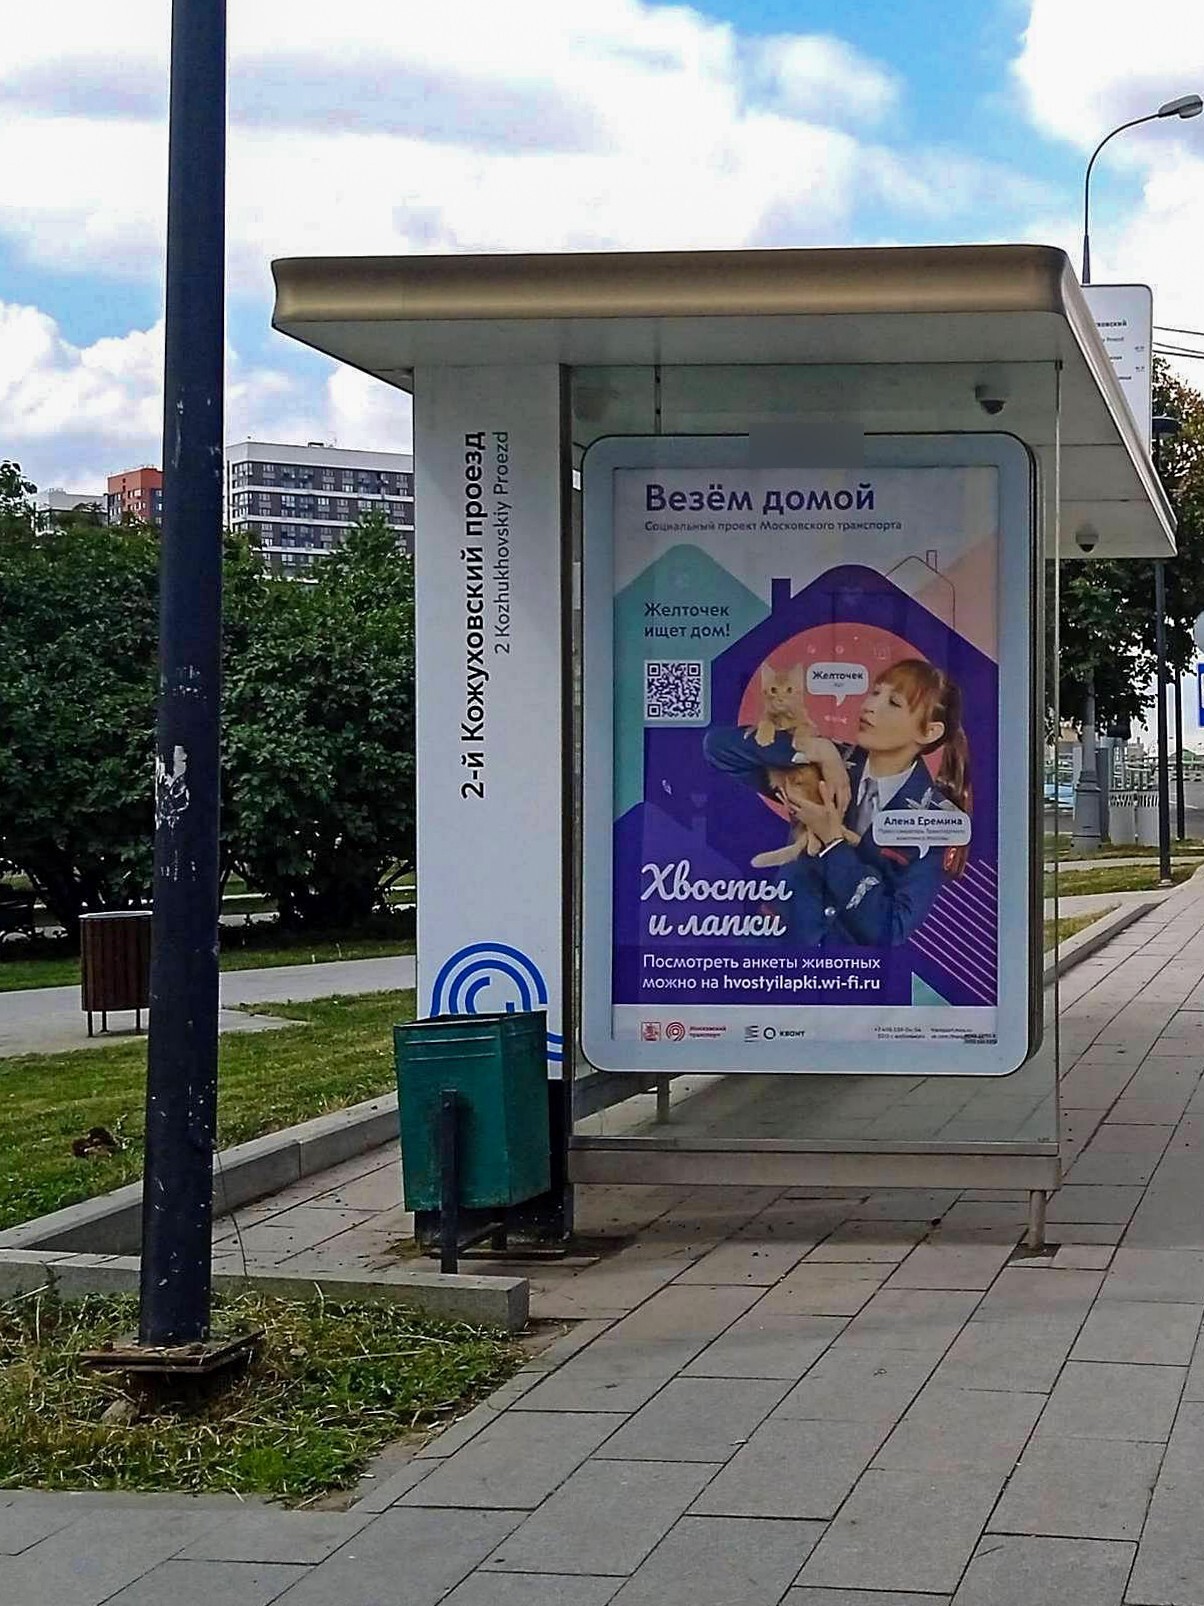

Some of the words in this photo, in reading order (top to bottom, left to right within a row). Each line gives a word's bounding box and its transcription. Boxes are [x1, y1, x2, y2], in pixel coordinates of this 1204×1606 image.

[491, 431, 509, 496] Proezd
[464, 431, 489, 537] проезд
[645, 483, 753, 512] Везём
[762, 482, 875, 516] домой
[644, 520, 716, 533] Социальный
[717, 521, 757, 534] проект
[759, 520, 835, 532] Московского
[836, 521, 902, 533] транспорта
[493, 501, 512, 637] Kozhukhovskiy
[644, 602, 730, 617] Желточек
[644, 625, 688, 639] ищет
[690, 622, 730, 639] дом!
[460, 546, 490, 741] Кожуховский
[494, 642, 510, 655] 2
[812, 670, 864, 680] Желточек
[460, 752, 485, 799] 2-й
[883, 816, 915, 826] Алена
[917, 816, 963, 827] Еремина
[640, 859, 793, 902] Хвосты
[648, 913, 673, 937] и
[677, 914, 787, 937] лапки
[643, 954, 739, 971] Посмотреть
[742, 957, 798, 969] анкеты
[801, 958, 881, 969] животных
[642, 978, 697, 989] можно
[701, 978, 719, 989] на
[723, 974, 880, 992] hvostyilapki.wi-fi.ru
